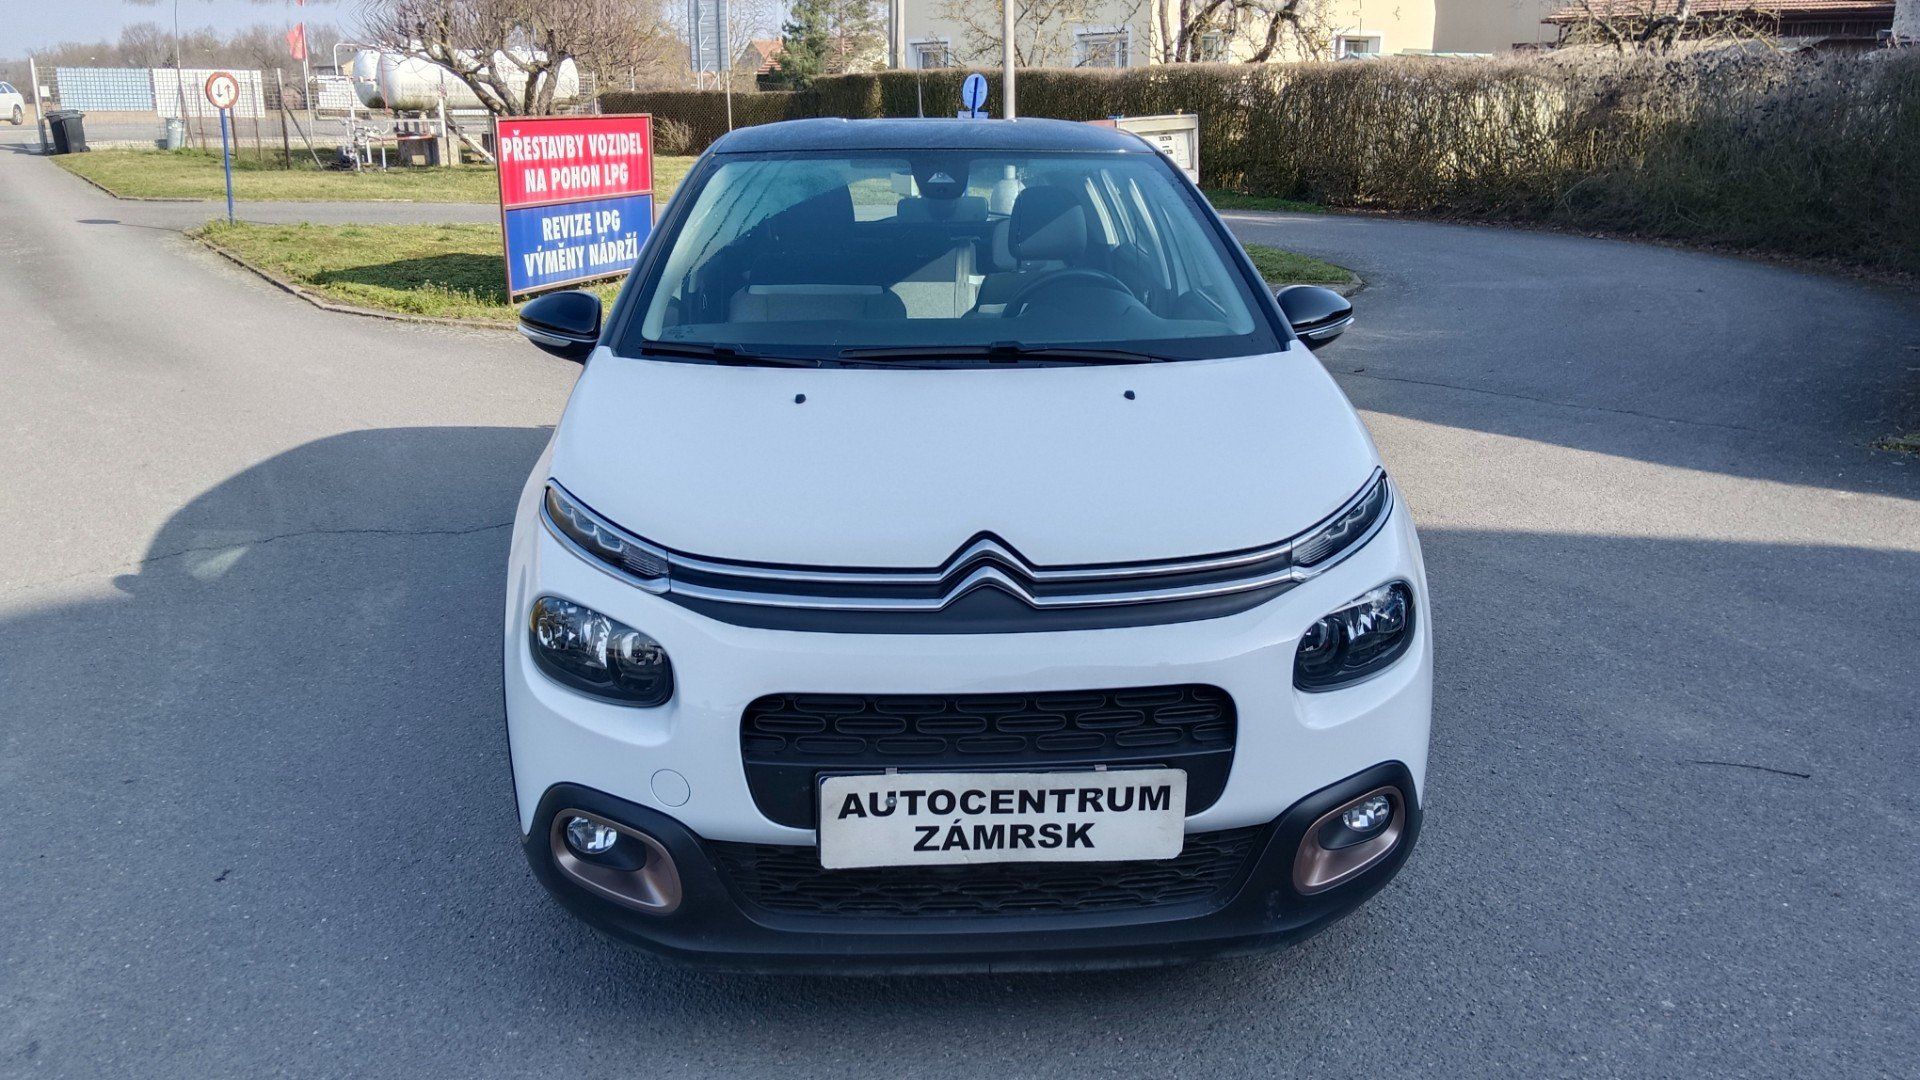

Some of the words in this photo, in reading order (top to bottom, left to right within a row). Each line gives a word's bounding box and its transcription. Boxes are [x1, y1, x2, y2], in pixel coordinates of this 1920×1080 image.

[501, 130, 585, 162] PŘESTAVBY
[588, 133, 643, 157] VOZIDEL
[525, 168, 548, 193] NA
[552, 165, 600, 190] POHON
[604, 163, 629, 187] LPG
[542, 213, 592, 241] REVIZE
[596, 210, 621, 234] LPG
[524, 242, 585, 277] VÝMĚNY
[589, 231, 638, 266] NÁDRŽÍ
[838, 785, 1171, 820] AUTOCENTRUM
[914, 818, 1096, 851] ZÁMRSK
